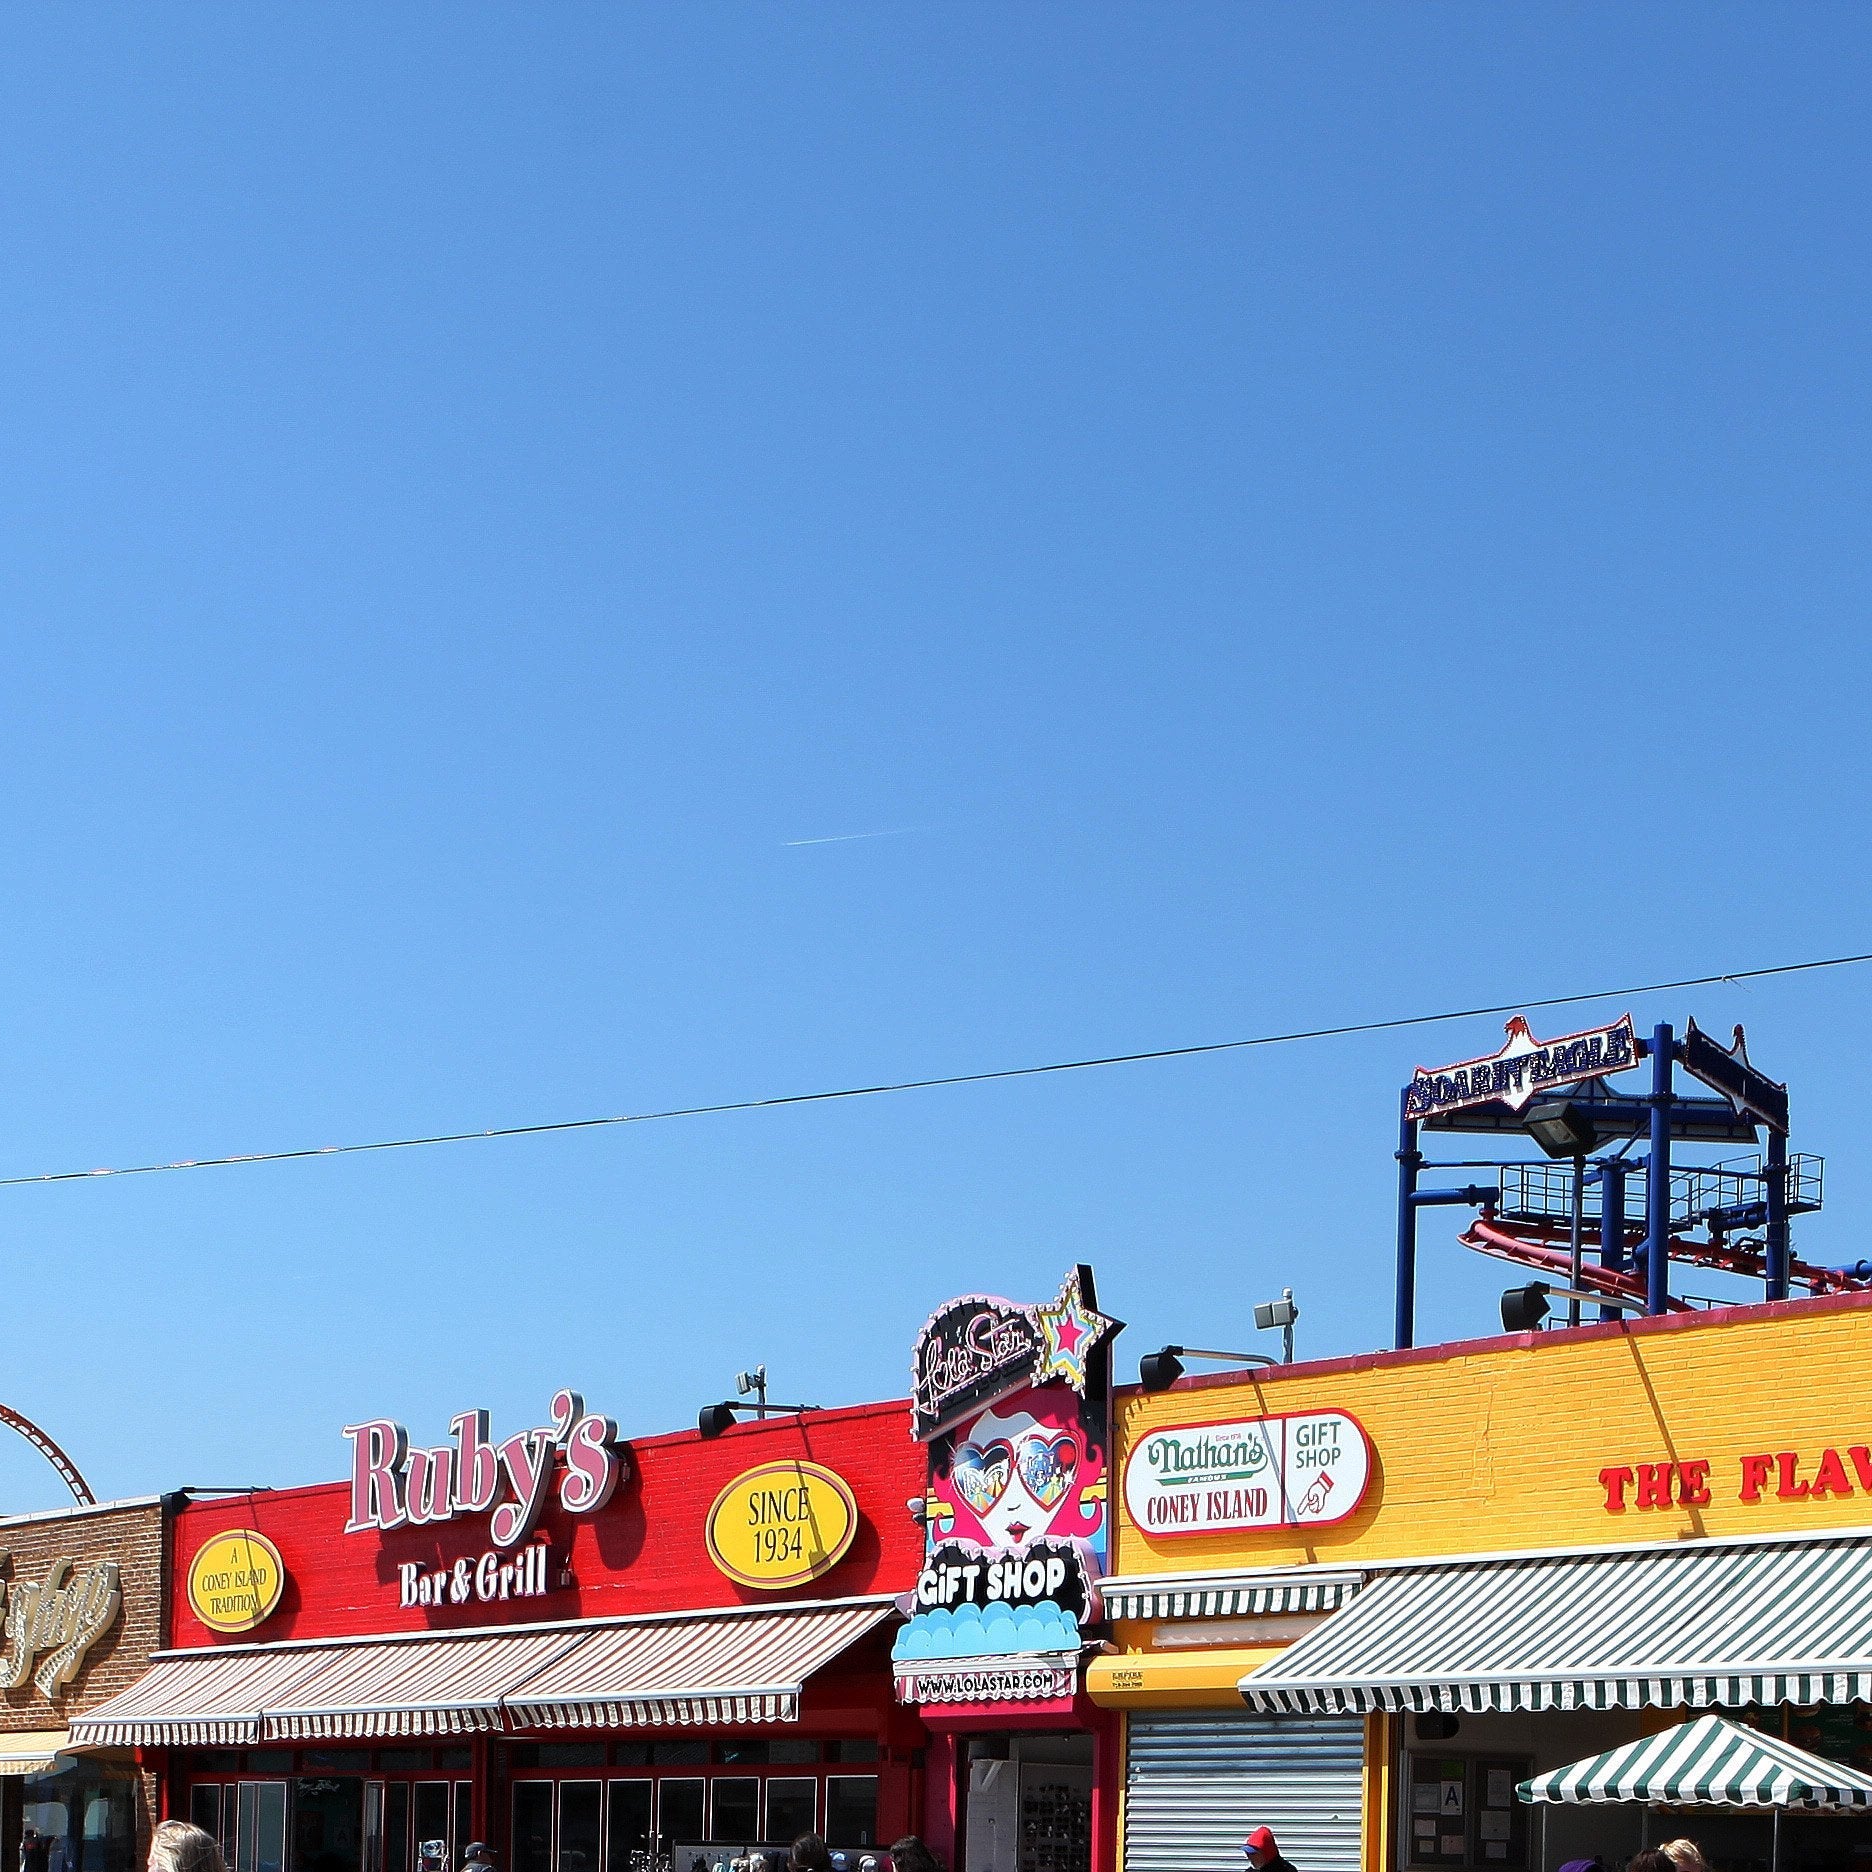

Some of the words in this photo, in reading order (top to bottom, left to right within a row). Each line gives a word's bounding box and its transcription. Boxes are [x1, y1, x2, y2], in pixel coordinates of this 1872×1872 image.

[918, 1339, 976, 1415] Lola
[965, 1312, 1032, 1371] Star
[1147, 1431, 1269, 1474] Nathan's
[1295, 1421, 1342, 1447] GIFT
[342, 1387, 618, 1548] Ruby's
[1295, 1447, 1342, 1468] SHOP
[1599, 1458, 1711, 1511] THE
[748, 1486, 810, 1526] SINCE
[1147, 1493, 1201, 1525] CONEY
[1206, 1487, 1268, 1521] ISLAND
[231, 1547, 238, 1564] A
[753, 1526, 803, 1563] 1934
[202, 1571, 232, 1592] CONEY
[235, 1567, 267, 1588] ISLAND
[398, 1560, 448, 1609] Bar
[475, 1543, 548, 1602] Grill
[986, 1557, 1066, 1600] SHOP
[210, 1593, 258, 1615] TRADITION
[918, 1673, 1054, 1696] WWW.LOLASTAR.COM
[1444, 1785, 1459, 1806] A
